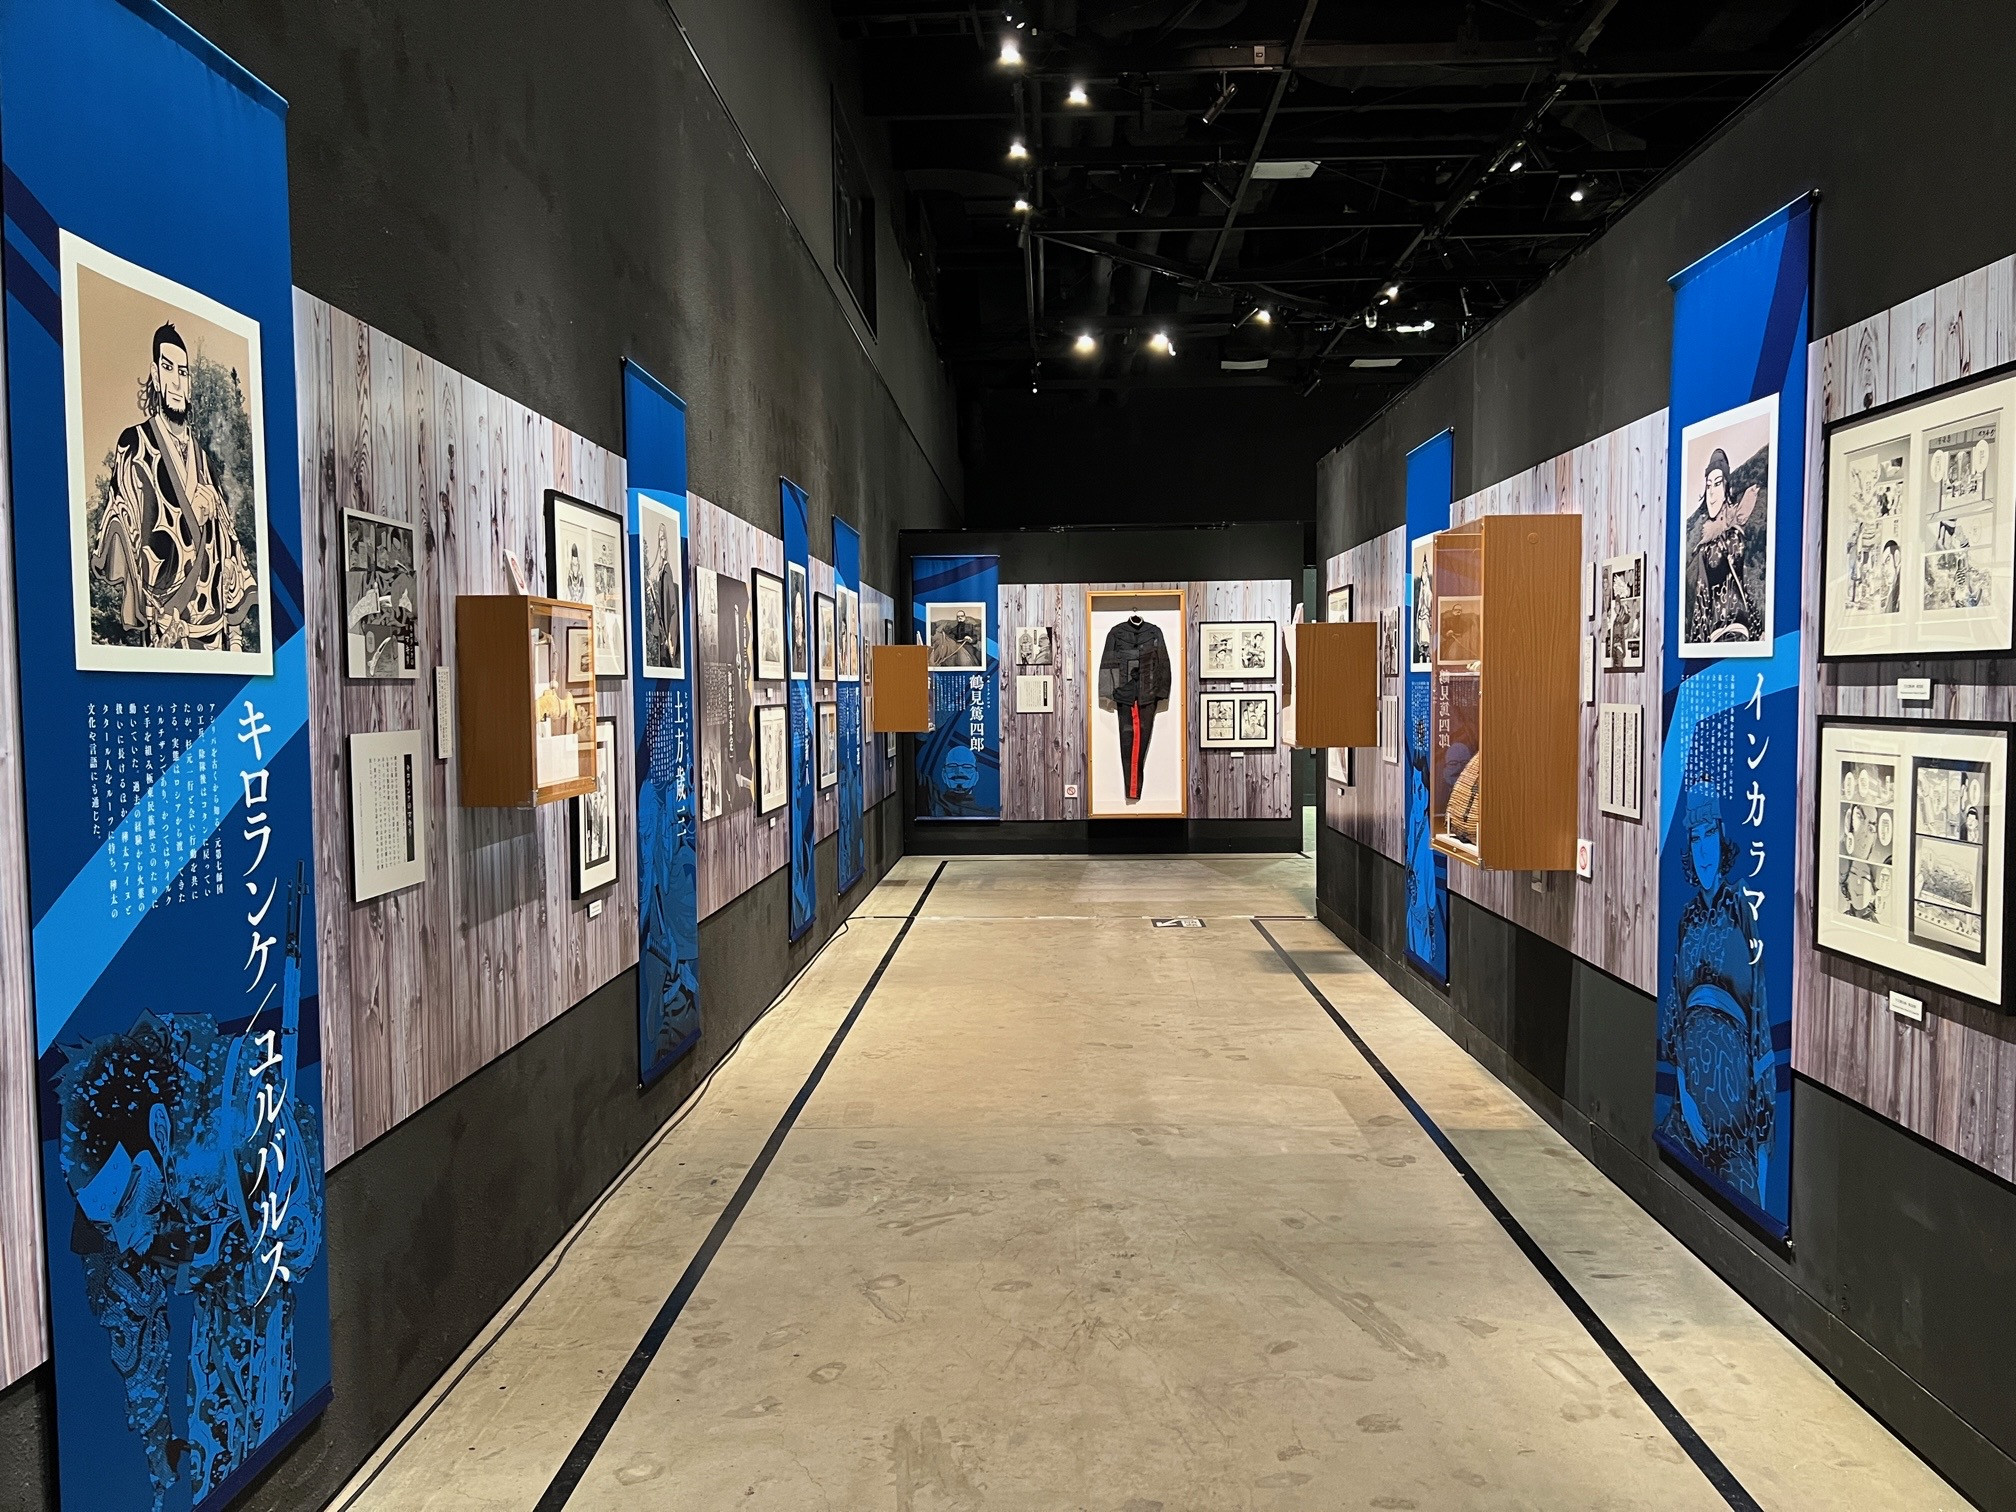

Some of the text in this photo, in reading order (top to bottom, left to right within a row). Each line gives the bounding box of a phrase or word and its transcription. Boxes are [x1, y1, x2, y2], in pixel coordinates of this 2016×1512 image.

[674, 690, 687, 836] 土方歳三
[969, 674, 985, 752] 鶴見篤四郎
